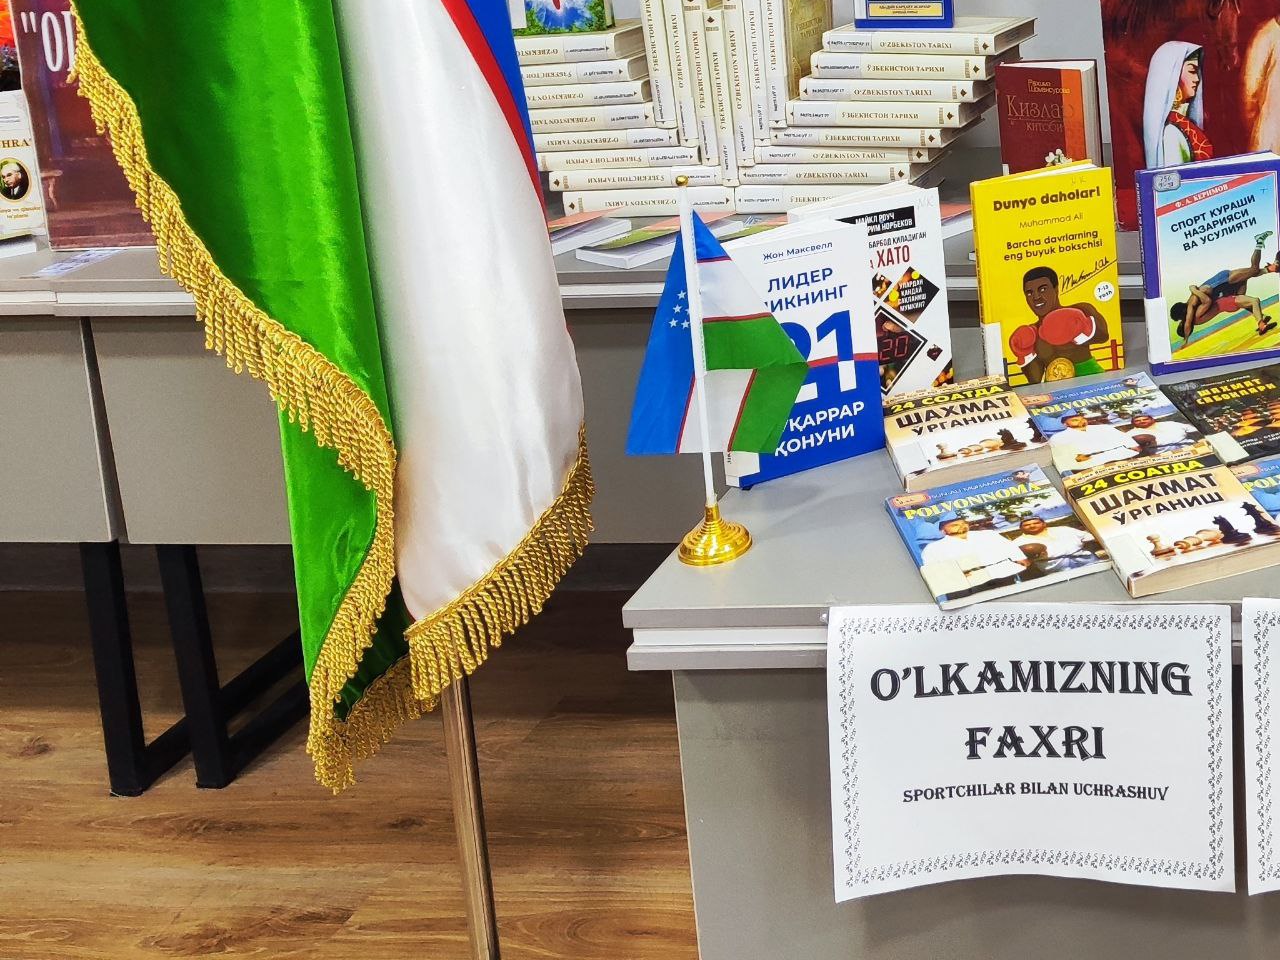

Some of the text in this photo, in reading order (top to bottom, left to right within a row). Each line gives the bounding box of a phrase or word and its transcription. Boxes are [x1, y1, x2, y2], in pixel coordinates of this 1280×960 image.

[993, 186, 1100, 211] Dunyo daholari
[1193, 184, 1229, 201] КЕРИМОВ
[879, 212, 895, 223] РОУЧ
[881, 218, 913, 230] НОРБЕКОВ
[1019, 212, 1083, 228] Muhammad Ali
[1170, 194, 1256, 232] СПОРТ КУРАШИ
[1184, 208, 1250, 239] НАЗАРИЯСИ
[868, 239, 892, 249] БАРБОД
[1007, 230, 1098, 250] Barcha davrlarning
[1183, 217, 1257, 251] ВА УСУЛИЯТИ
[762, 242, 833, 261] Жон Максвелл
[876, 245, 910, 268] ХАТО
[1004, 239, 1103, 261] eng buyuk bokschisi
[767, 267, 833, 293] ЛИДЕР
[891, 401, 916, 414] 24
[921, 384, 1004, 405] СОАТДА
[1196, 378, 1263, 397] ШАХМАТ
[895, 396, 1011, 429] ШАХМАТ
[1080, 478, 1108, 495] 24
[1114, 459, 1205, 483] СОАТДА
[1090, 473, 1218, 516] ШАХМАТ
[1112, 490, 1224, 525] ЎРГАНИШ
[870, 660, 1193, 701] O’LKAMIZNING
[965, 724, 1107, 762] FAXRI
[902, 782, 1170, 803] SPORTCHILAR BILAN UCHRASHUV
